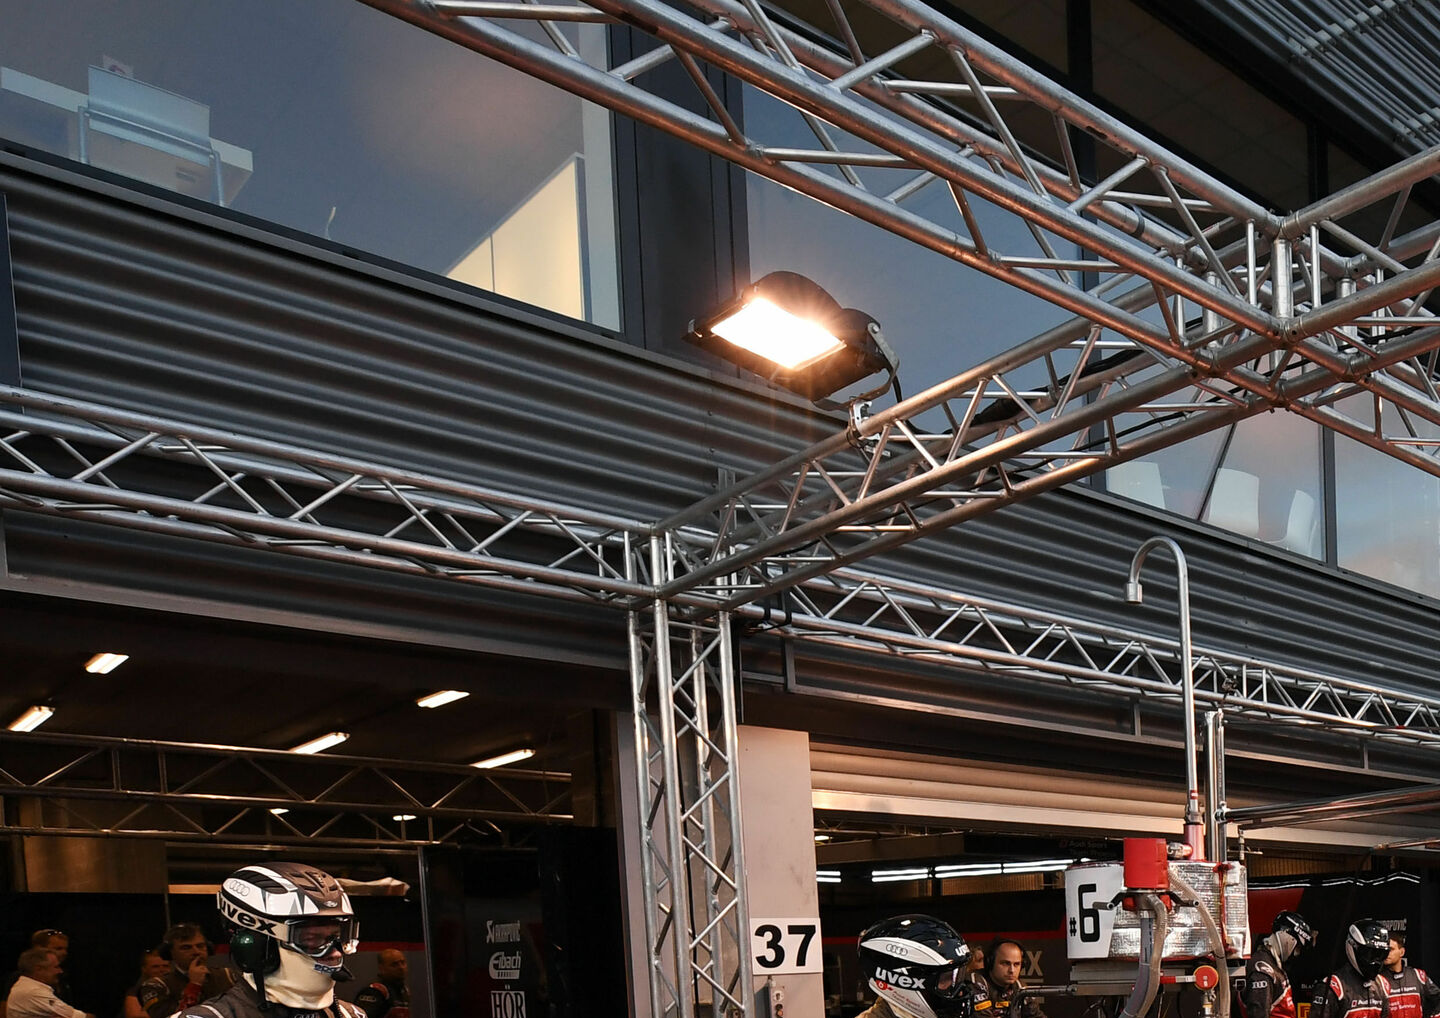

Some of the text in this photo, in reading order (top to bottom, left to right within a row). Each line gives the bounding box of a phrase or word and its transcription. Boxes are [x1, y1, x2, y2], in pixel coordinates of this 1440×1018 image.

[1068, 883, 1101, 943] #6
[488, 950, 522, 980] Eibach
[754, 924, 817, 969] 37
[874, 966, 926, 991] uvex
